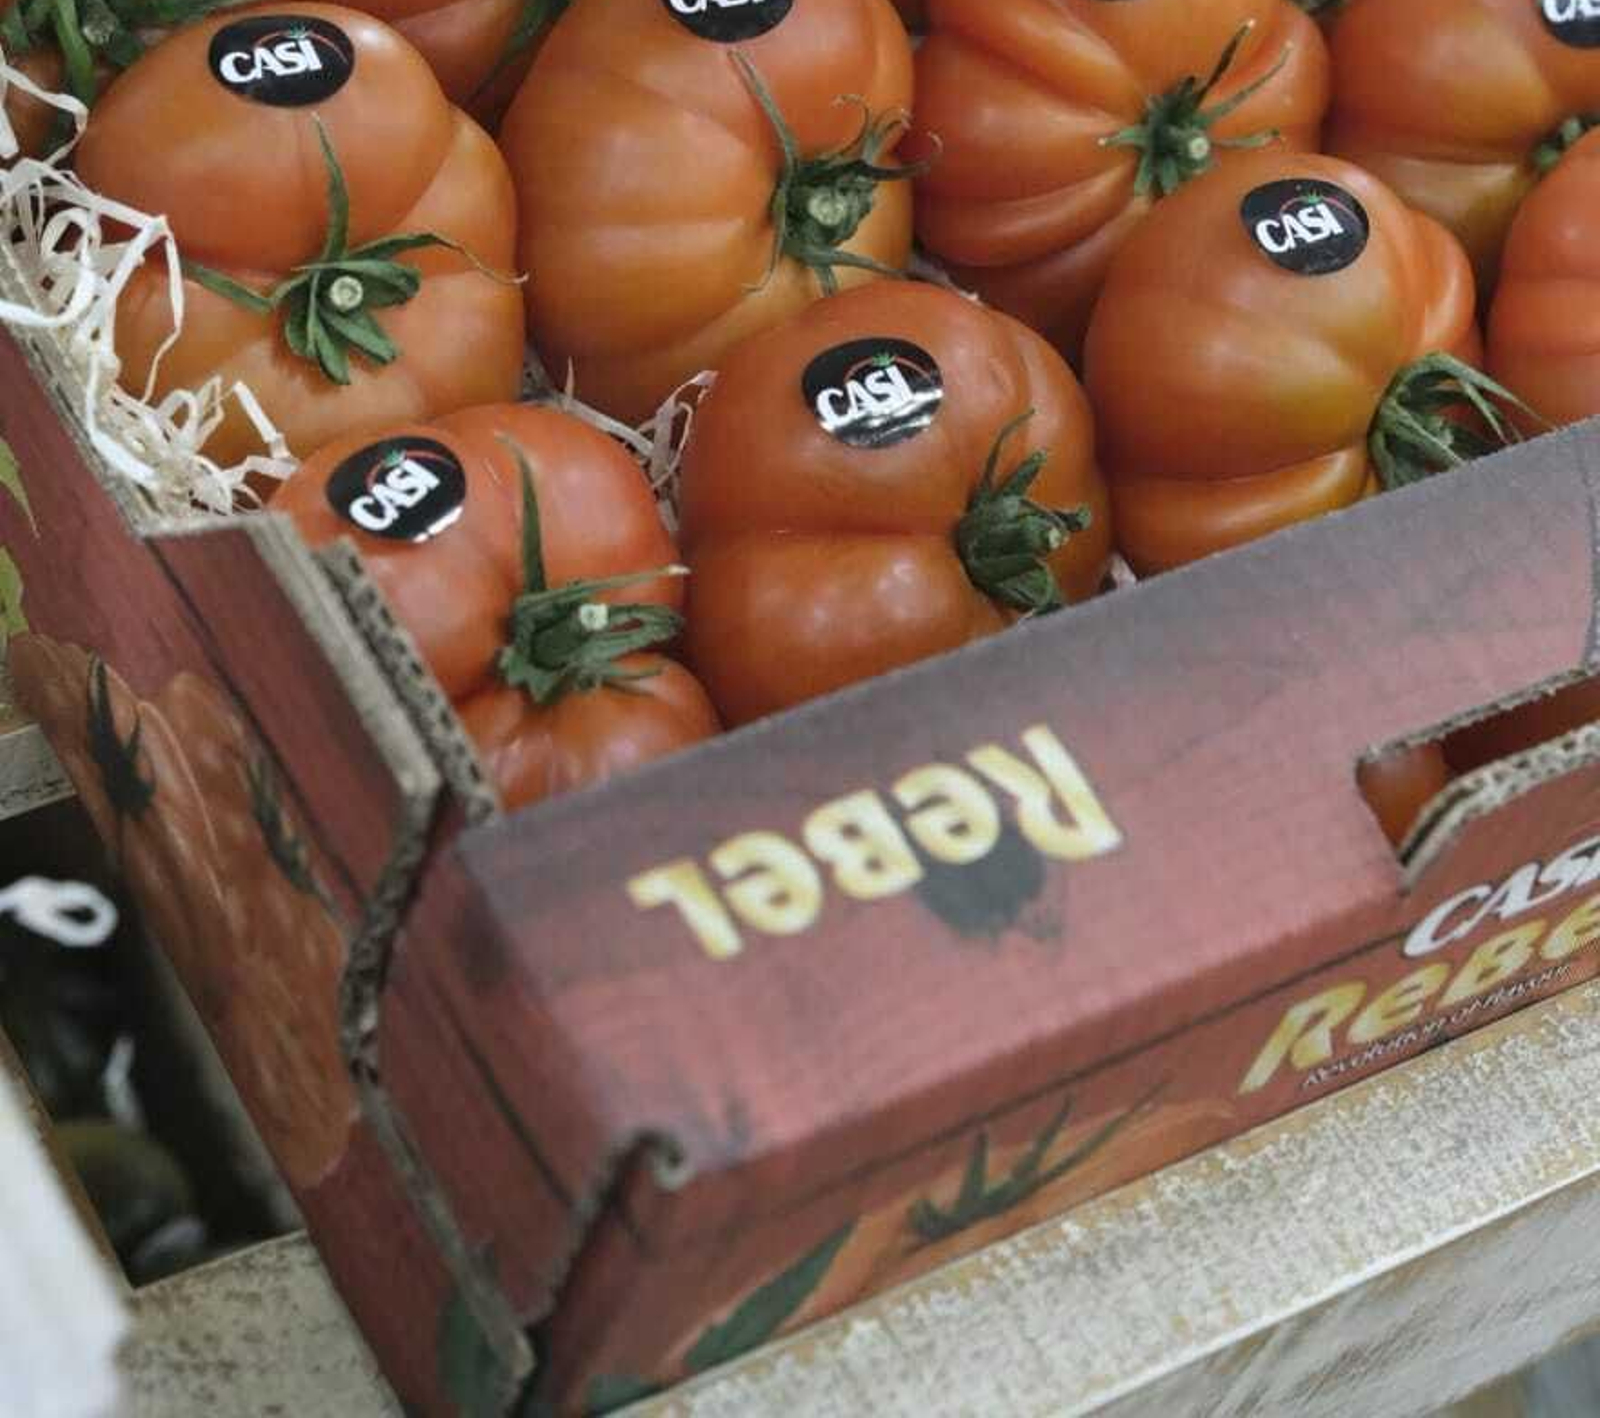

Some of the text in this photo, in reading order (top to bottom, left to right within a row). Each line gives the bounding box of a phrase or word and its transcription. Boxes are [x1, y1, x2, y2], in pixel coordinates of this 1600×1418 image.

[219, 37, 323, 84] CASI
[1255, 201, 1343, 254] CASI
[814, 364, 917, 428] CASI
[349, 456, 441, 531] CASI
